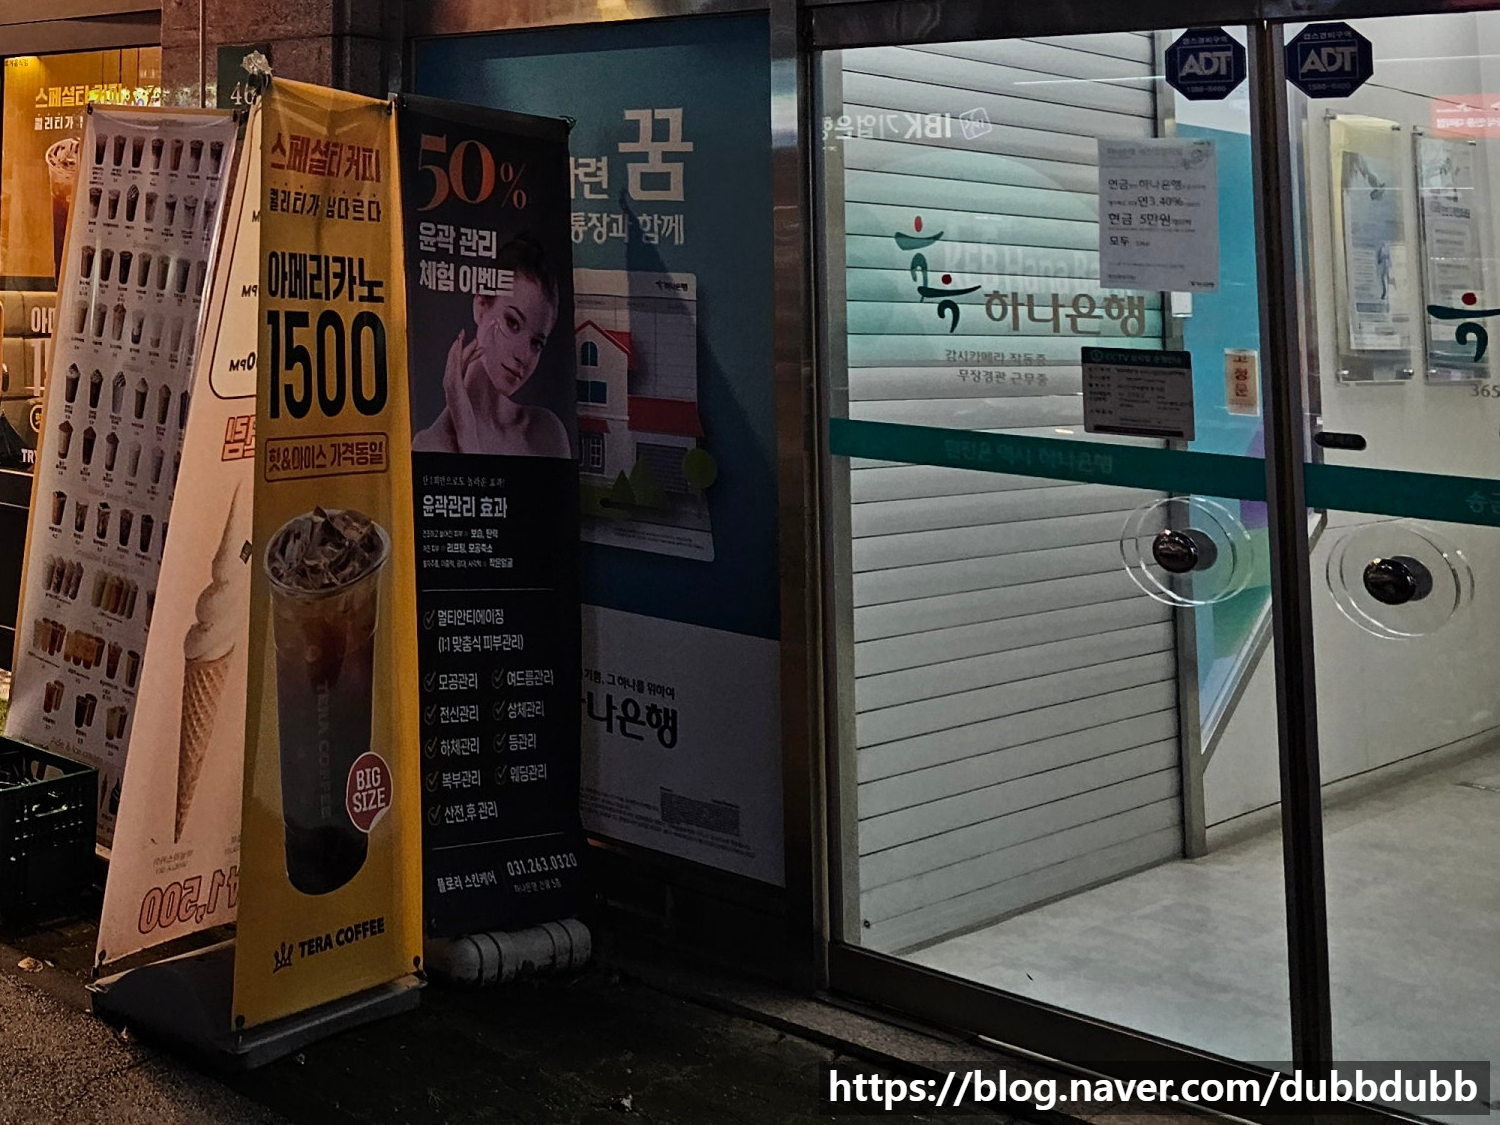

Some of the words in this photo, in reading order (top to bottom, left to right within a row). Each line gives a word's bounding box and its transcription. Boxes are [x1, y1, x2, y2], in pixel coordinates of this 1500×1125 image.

[1179, 51, 1233, 77] ADT
[1300, 46, 1357, 74] ADT
[271, 132, 343, 179] 스페셜티
[344, 144, 381, 184] 커피
[618, 108, 694, 201] 꿈
[417, 132, 527, 213] 50%
[270, 187, 320, 217] 퀄리티가
[326, 194, 382, 223] 남다르다
[418, 222, 454, 257] 윤곽
[459, 227, 497, 259] 관리
[638, 213, 685, 246] 함께
[267, 250, 385, 304] 아메리카노
[419, 261, 455, 293] 체험
[458, 262, 515, 298] 이벤트
[983, 289, 1146, 338] 하나은행
[266, 310, 388, 419] 1500
[268, 446, 327, 475] 핫&아이스
[329, 440, 385, 470] 가격동일
[423, 494, 475, 518] 윤곽관리
[479, 496, 508, 519] 효과
[437, 608, 505, 627] 멀티안티에이징
[452, 635, 482, 653] 맞춤식
[483, 633, 524, 651] 피부관리)
[438, 672, 478, 690] 모공관리
[506, 668, 554, 687] 여드름관리
[439, 704, 479, 724] 전신관리
[507, 699, 545, 720] 상체관리
[580, 691, 678, 749] 나은행
[440, 736, 480, 757] 하체관리
[509, 733, 537, 752] 등관리
[355, 766, 382, 791] BIG
[441, 768, 481, 790] 복부관리
[352, 787, 386, 813] SIZE
[478, 800, 499, 820] 관리
[507, 852, 578, 877] 031.263.0320
[298, 934, 333, 959] TERA
[336, 917, 385, 950] COFFEE
